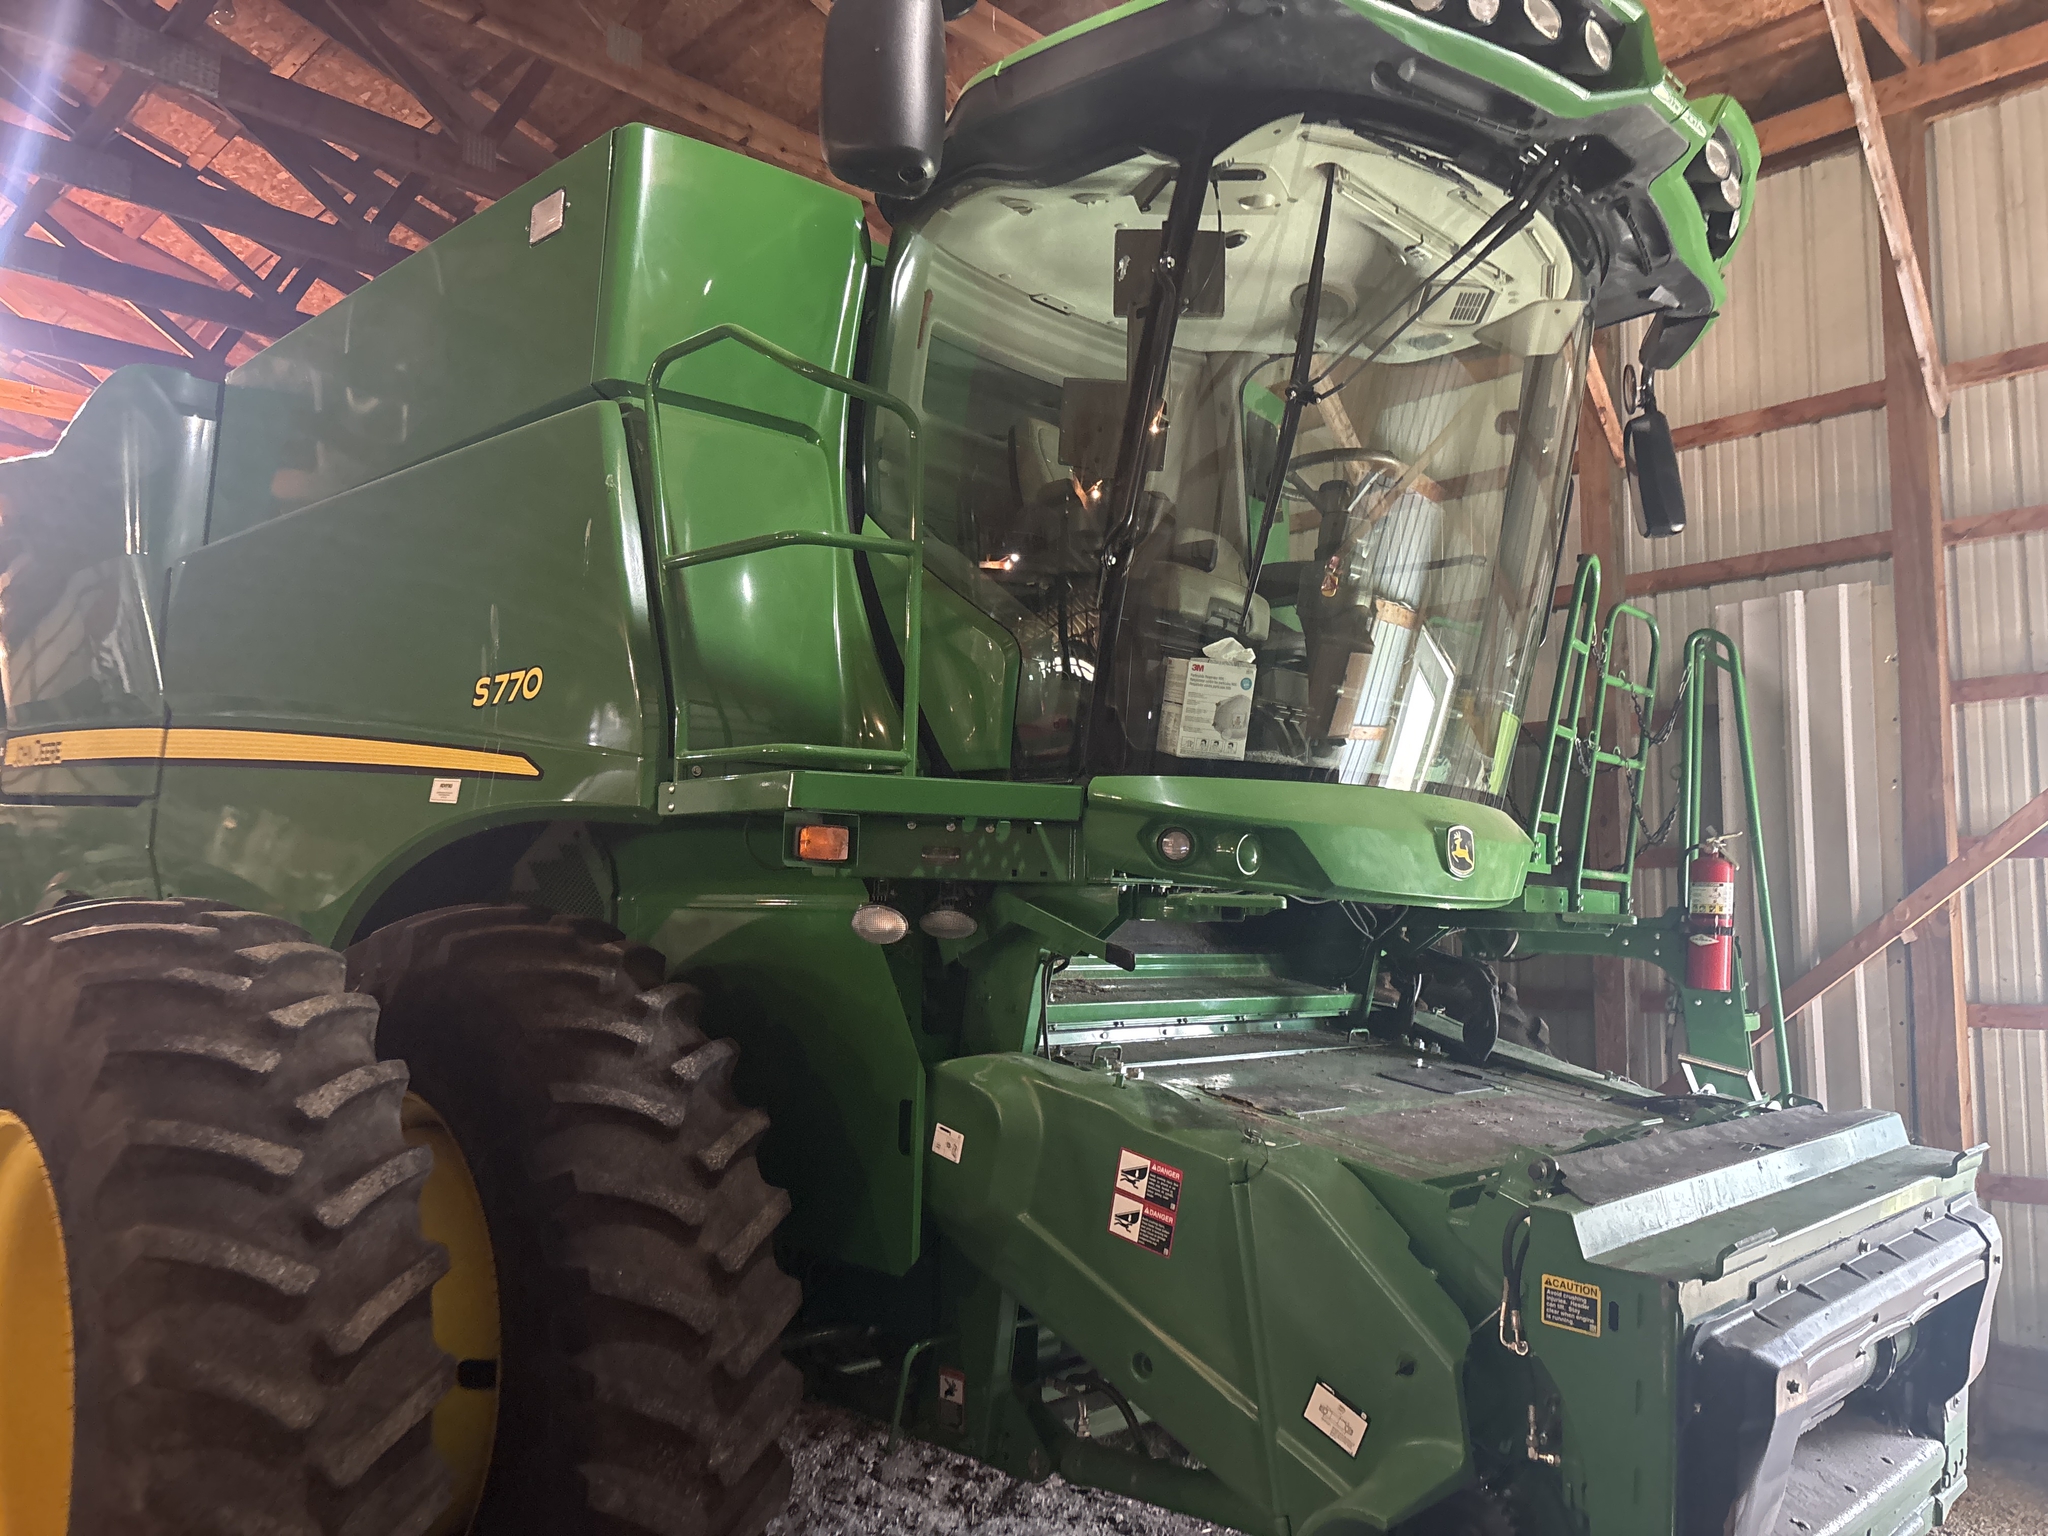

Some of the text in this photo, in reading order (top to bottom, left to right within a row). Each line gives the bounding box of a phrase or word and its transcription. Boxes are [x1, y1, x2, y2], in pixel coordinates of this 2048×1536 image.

[1191, 664, 1205, 672] 3M
[472, 666, 544, 707] S770
[1156, 1165, 1180, 1180] DANGER
[1150, 1209, 1174, 1224] DANGER
[1552, 1279, 1598, 1297] CAUTION
[1546, 1289, 1587, 1304] Avoid crushing
[1570, 1301, 1590, 1310] Header
[1560, 1311, 1575, 1319] when
[1575, 1315, 1595, 1324] engine
